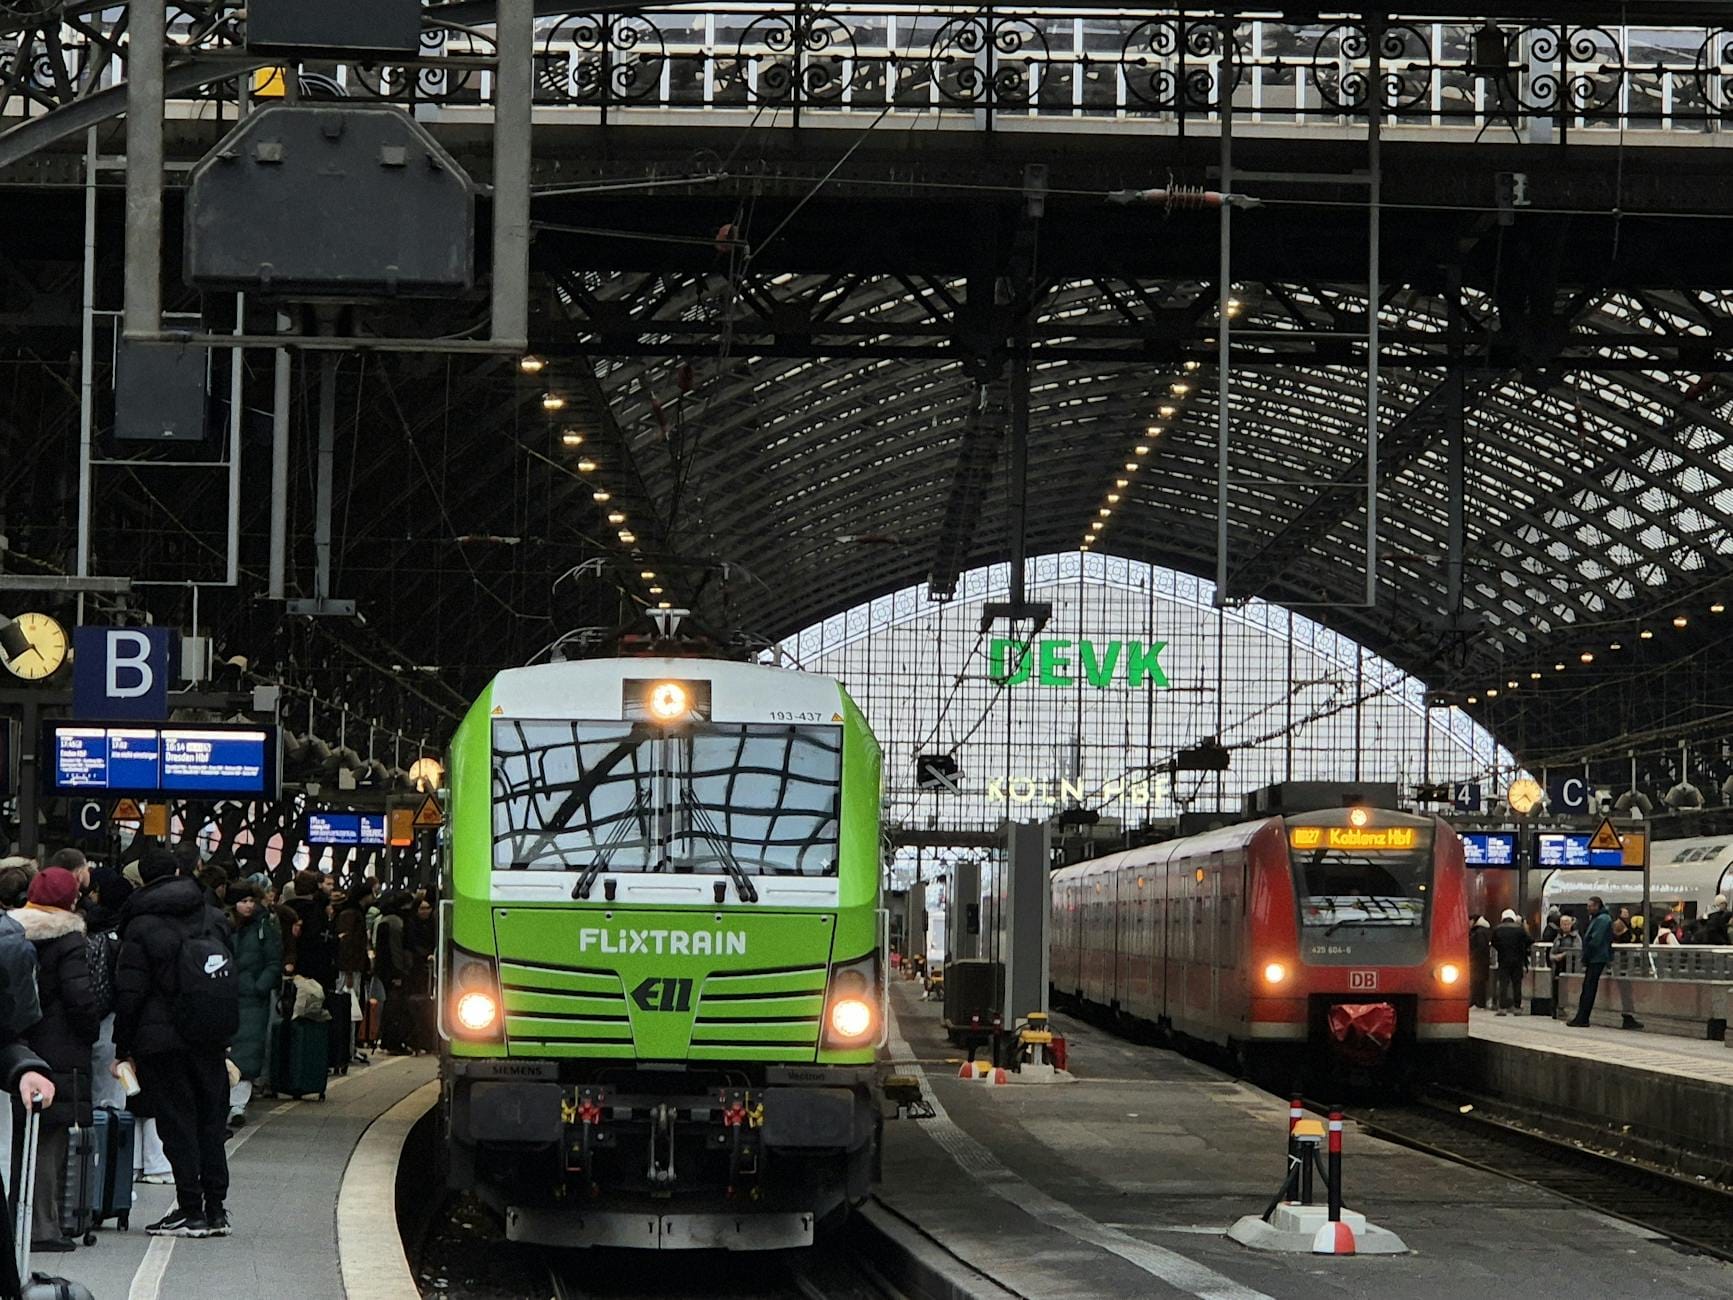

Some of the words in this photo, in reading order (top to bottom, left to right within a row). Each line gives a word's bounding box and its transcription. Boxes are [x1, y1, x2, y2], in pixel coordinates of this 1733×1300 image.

[106, 630, 154, 698] B
[989, 638, 1171, 687] DEVK
[769, 711, 822, 722] 193-437
[1457, 784, 1471, 806] 4
[1562, 778, 1583, 807] C
[80, 802, 101, 831] C
[1330, 828, 1386, 845] Koblenz
[579, 927, 747, 955] FLiXTRAIN
[1351, 972, 1375, 988] DB
[492, 1066, 543, 1077] SIEMENS
